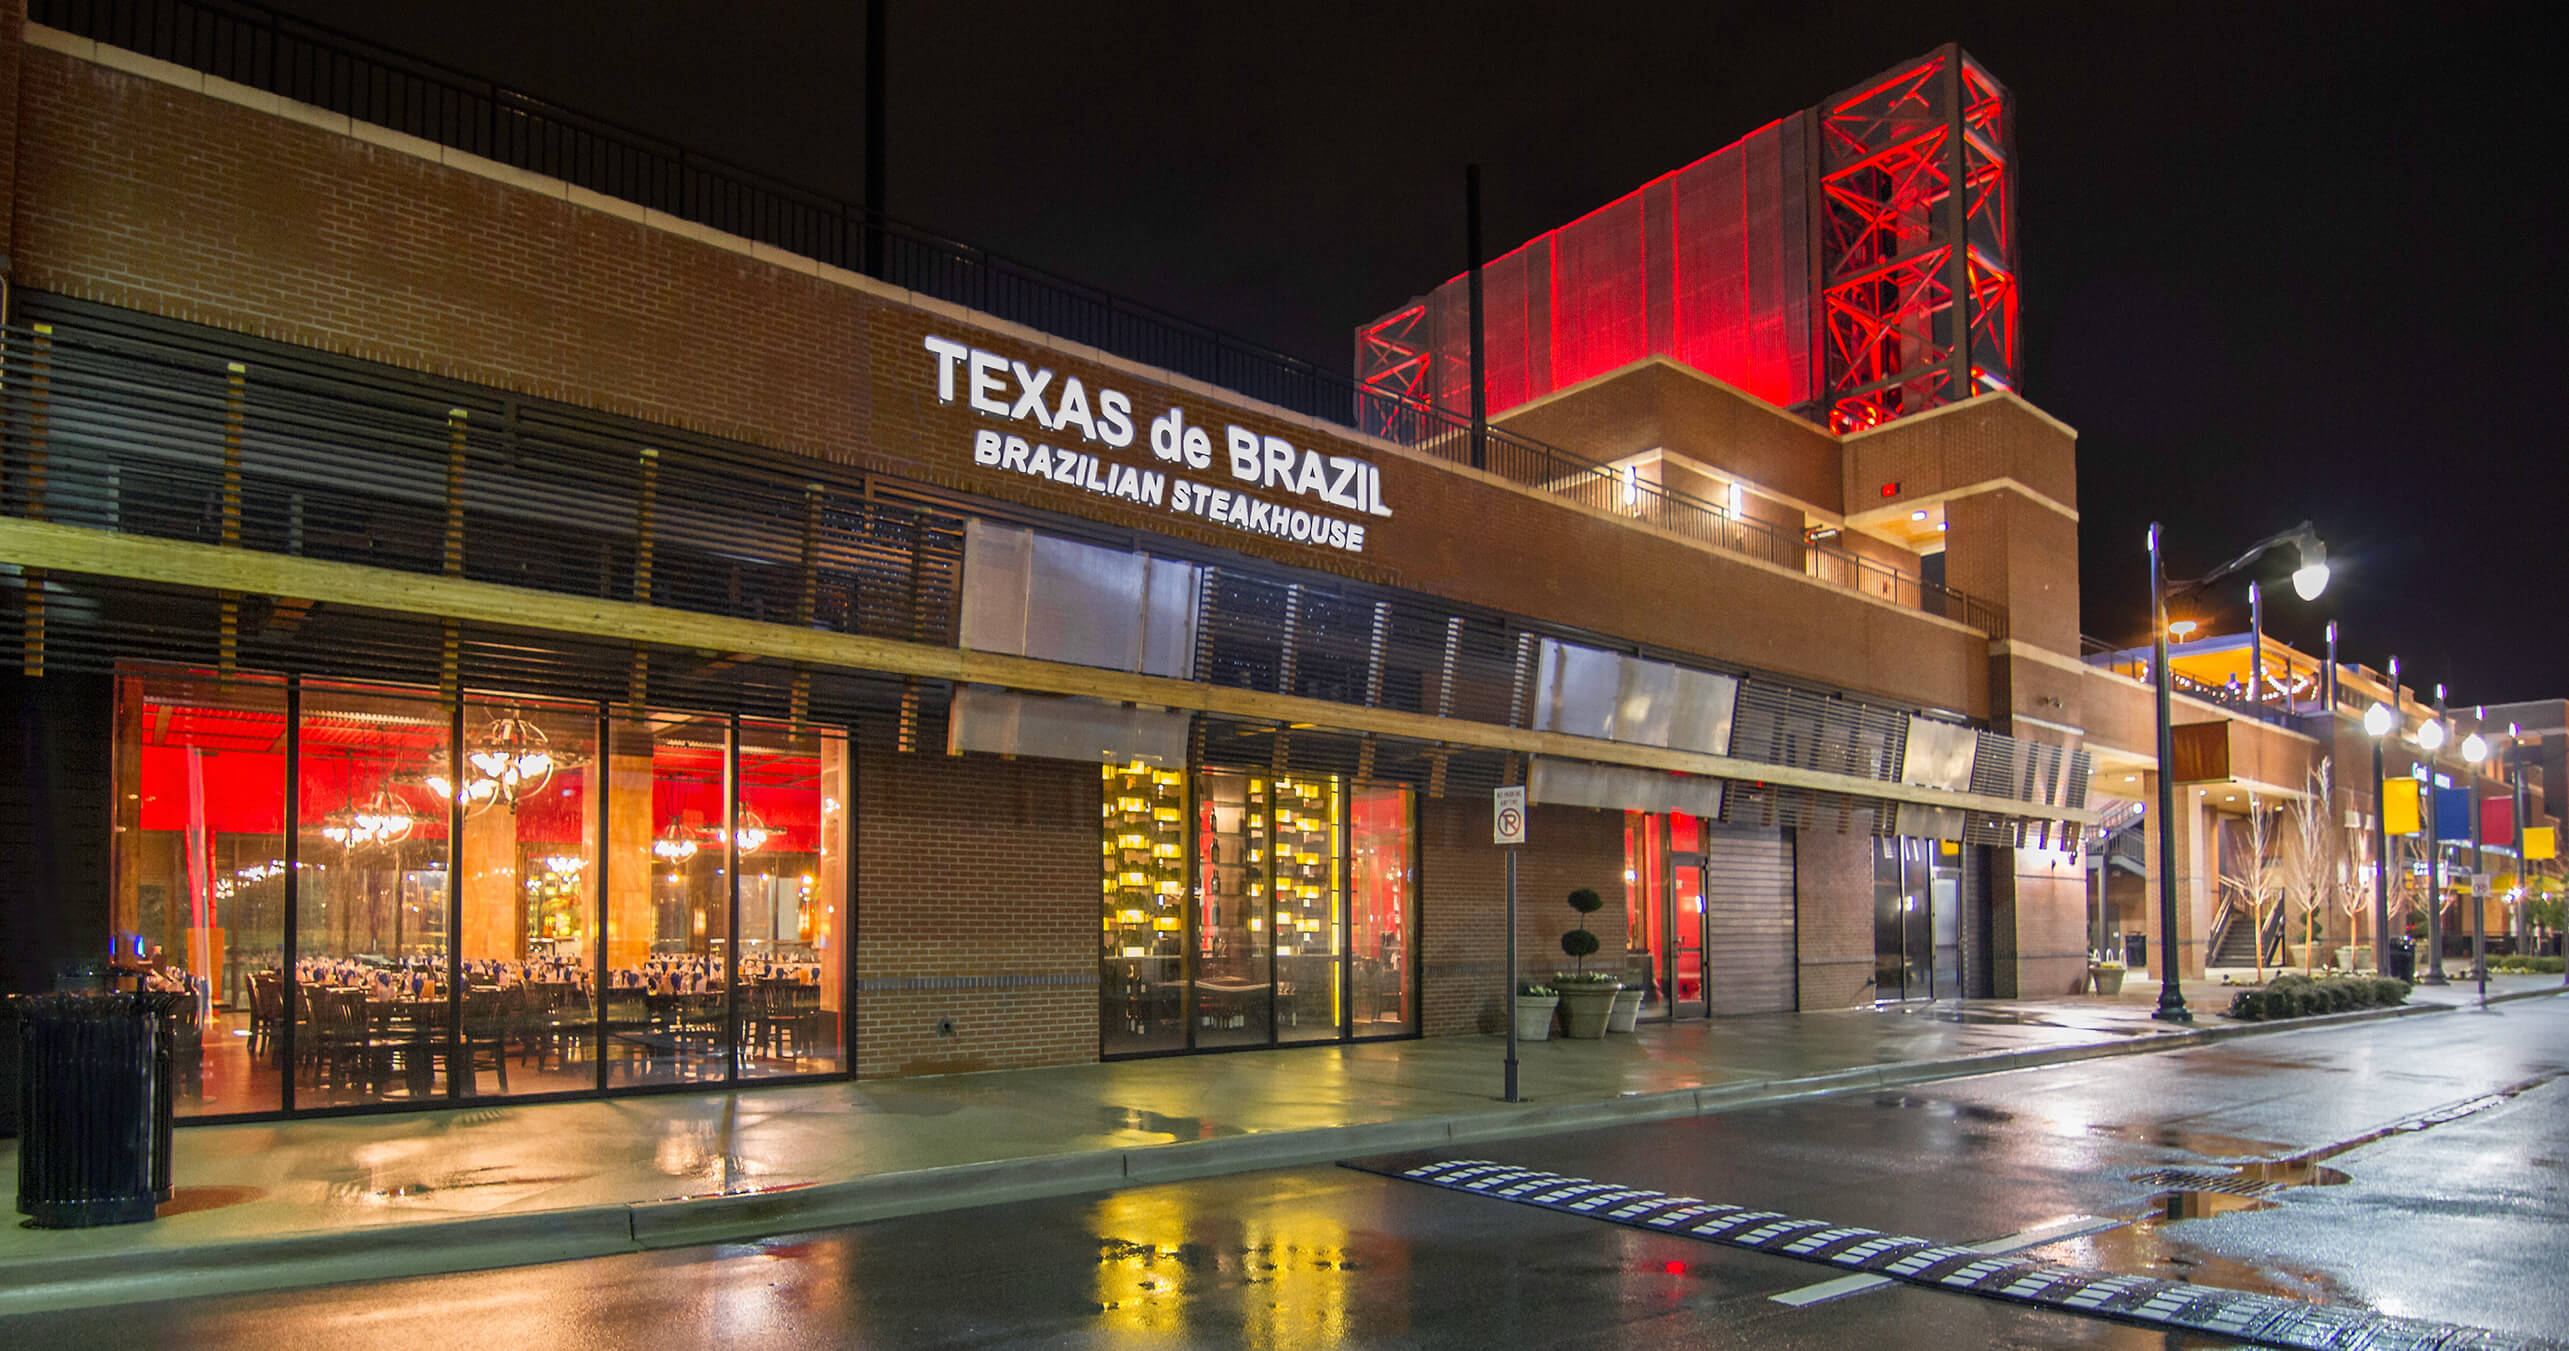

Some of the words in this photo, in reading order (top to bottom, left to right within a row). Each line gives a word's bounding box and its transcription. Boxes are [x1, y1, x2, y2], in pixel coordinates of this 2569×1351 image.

[924, 336, 1134, 447] TEXAS
[1150, 408, 1212, 469] de
[1228, 425, 1393, 517] BRAZIL
[974, 430, 1165, 505] BRAZILIAN
[1171, 480, 1365, 552] STEAKHOUSE
